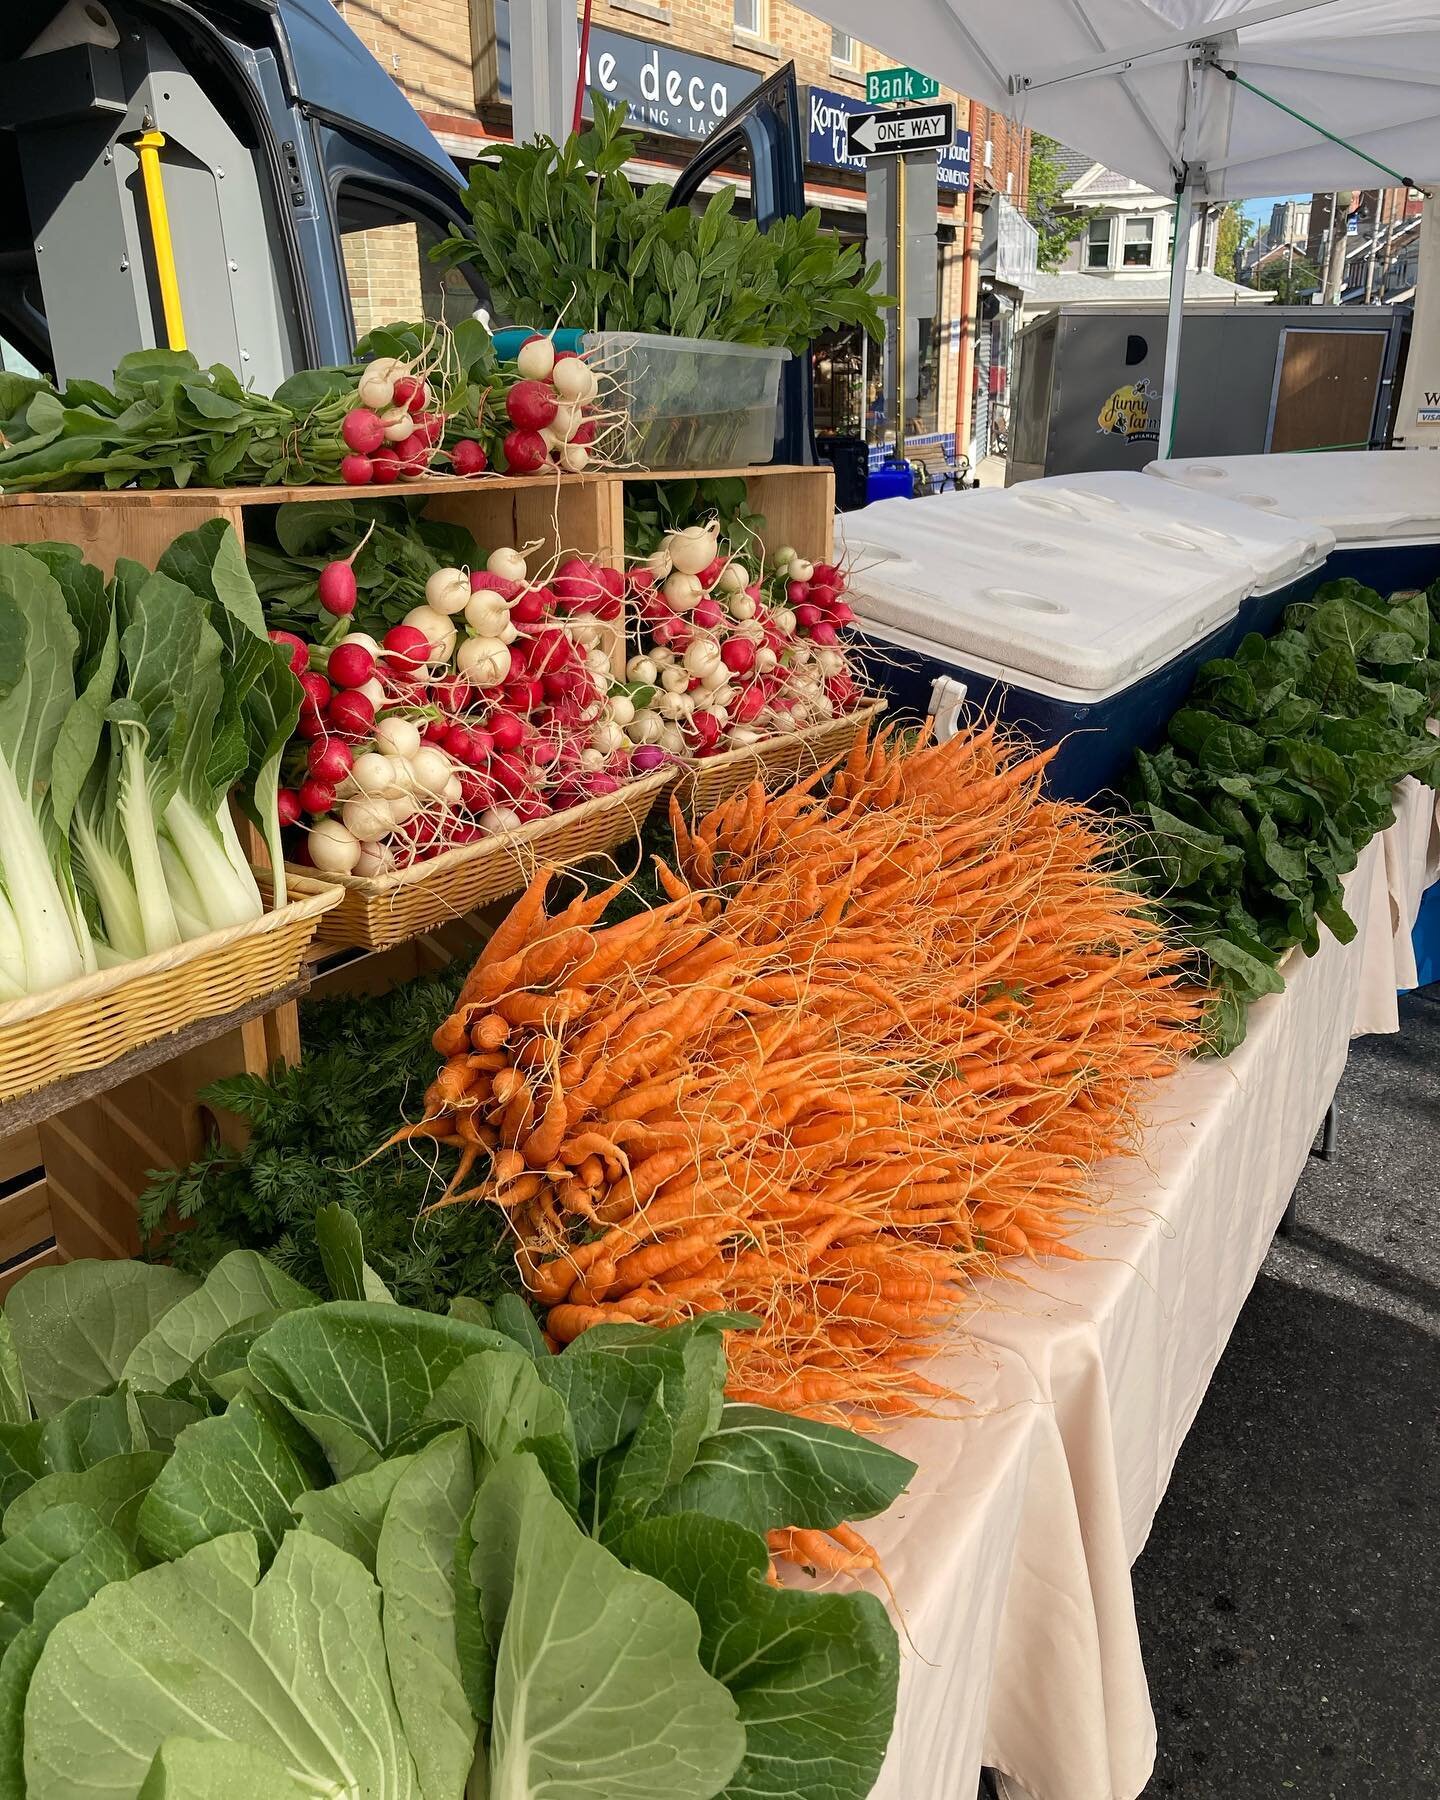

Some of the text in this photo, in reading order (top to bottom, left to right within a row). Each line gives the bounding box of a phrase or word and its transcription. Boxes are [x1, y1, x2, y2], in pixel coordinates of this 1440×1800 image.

[870, 72, 914, 100] Bank
[606, 99, 720, 135] WXING LAS
[877, 117, 941, 140] ONE WAY
[1104, 394, 1149, 422] funny
